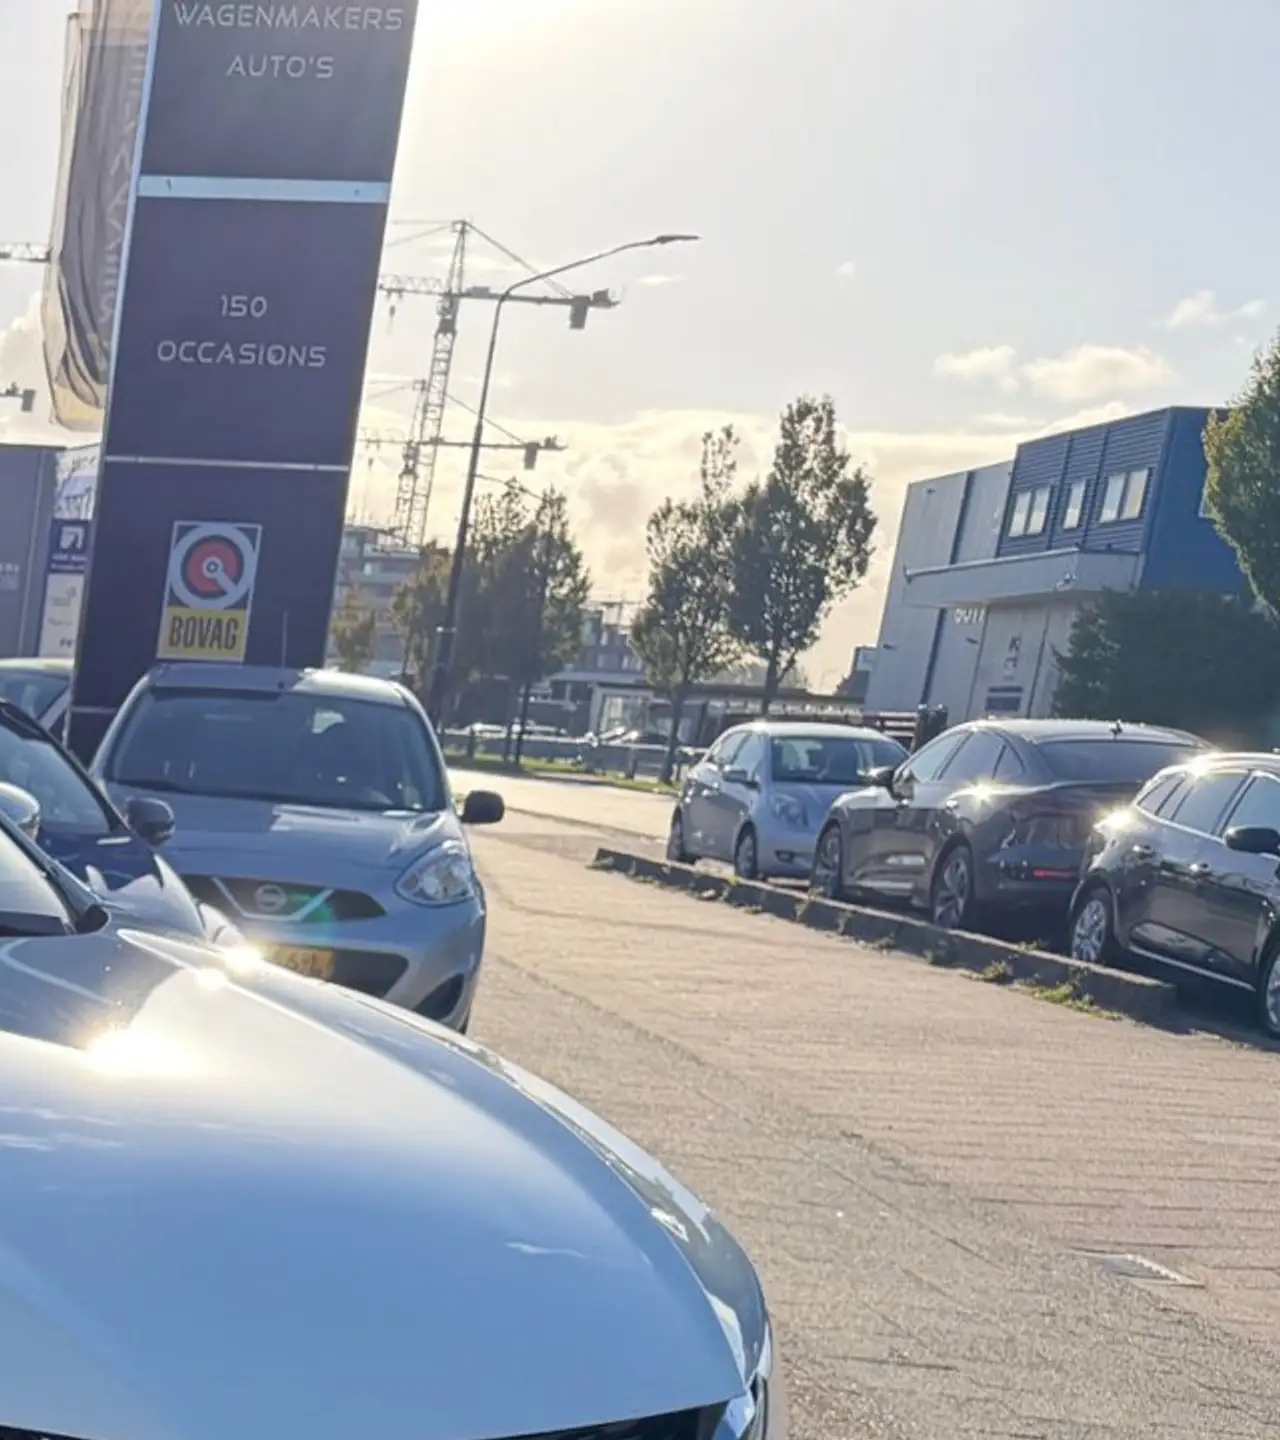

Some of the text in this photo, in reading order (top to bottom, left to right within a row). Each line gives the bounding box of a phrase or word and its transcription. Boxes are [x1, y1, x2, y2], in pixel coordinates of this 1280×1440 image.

[172, 3, 404, 31] WAGENMAKERS
[226, 55, 335, 79] AUTO'S
[220, 294, 268, 318] 150
[156, 340, 328, 368] OCCASIONS
[168, 615, 240, 651] BOVAG
